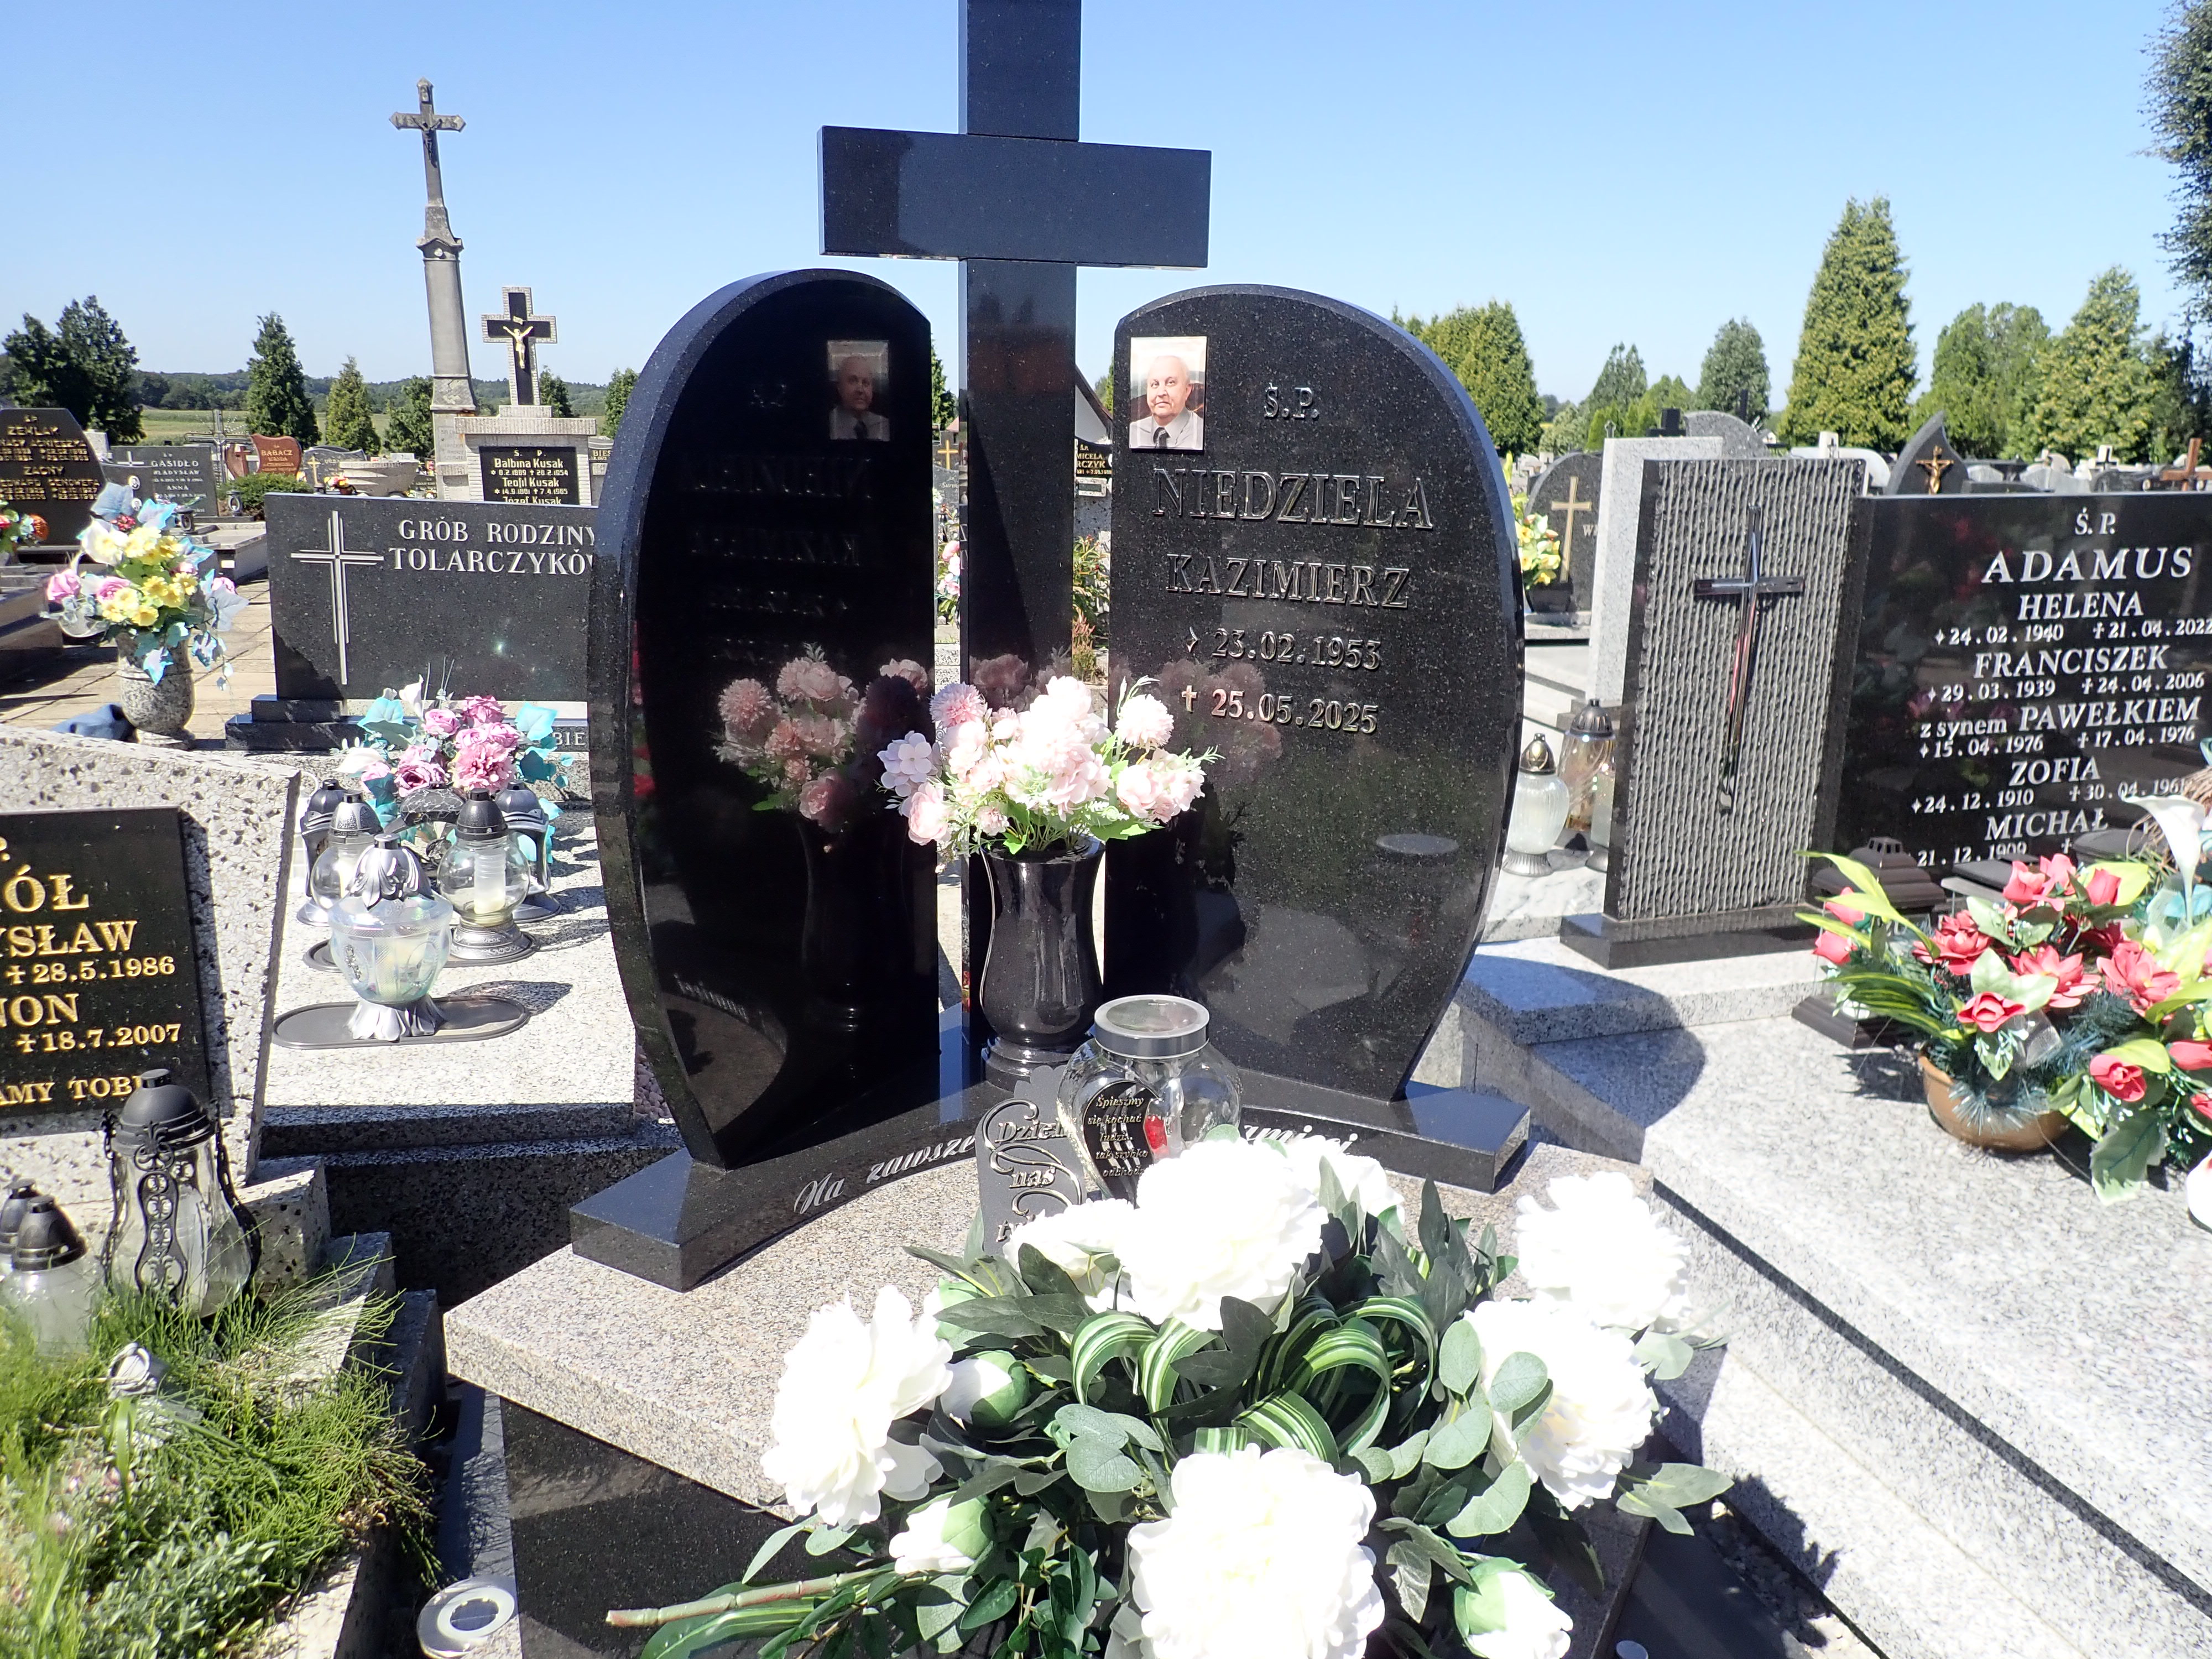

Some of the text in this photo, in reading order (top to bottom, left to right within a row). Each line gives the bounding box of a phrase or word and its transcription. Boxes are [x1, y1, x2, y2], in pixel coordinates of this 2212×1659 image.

[494, 458, 564, 468] Balbina Kusak
[502, 477, 560, 488] Teofil Kusak
[1152, 467, 1433, 529] NIEDZIELA
[399, 516, 469, 543] GRÓB
[389, 547, 593, 576] TOLARCZYKÓ
[1981, 546, 2192, 584] ADAMUS
[1165, 554, 1410, 608] KAZIMIERZ
[2018, 591, 2143, 620] HELENA
[1212, 628, 1382, 671] 23.02.1953
[1973, 644, 2171, 679] FRANCISZEK
[1211, 688, 1379, 735] 25.05.2025
[1921, 697, 2201, 741] z synem PAWEŁKIEM
[2008, 757, 2101, 787] ZOFIA
[1984, 807, 2109, 841] MICHAŁ
[0, 864, 89, 912] ÓŁ
[32, 956, 176, 984] 28.5.1986
[40, 1023, 181, 1052] 18.7.2007
[1095, 1147, 1149, 1161] tak szybko
[794, 1135, 976, 1215] Na zawsze
[1009, 1166, 1056, 1189] nas
